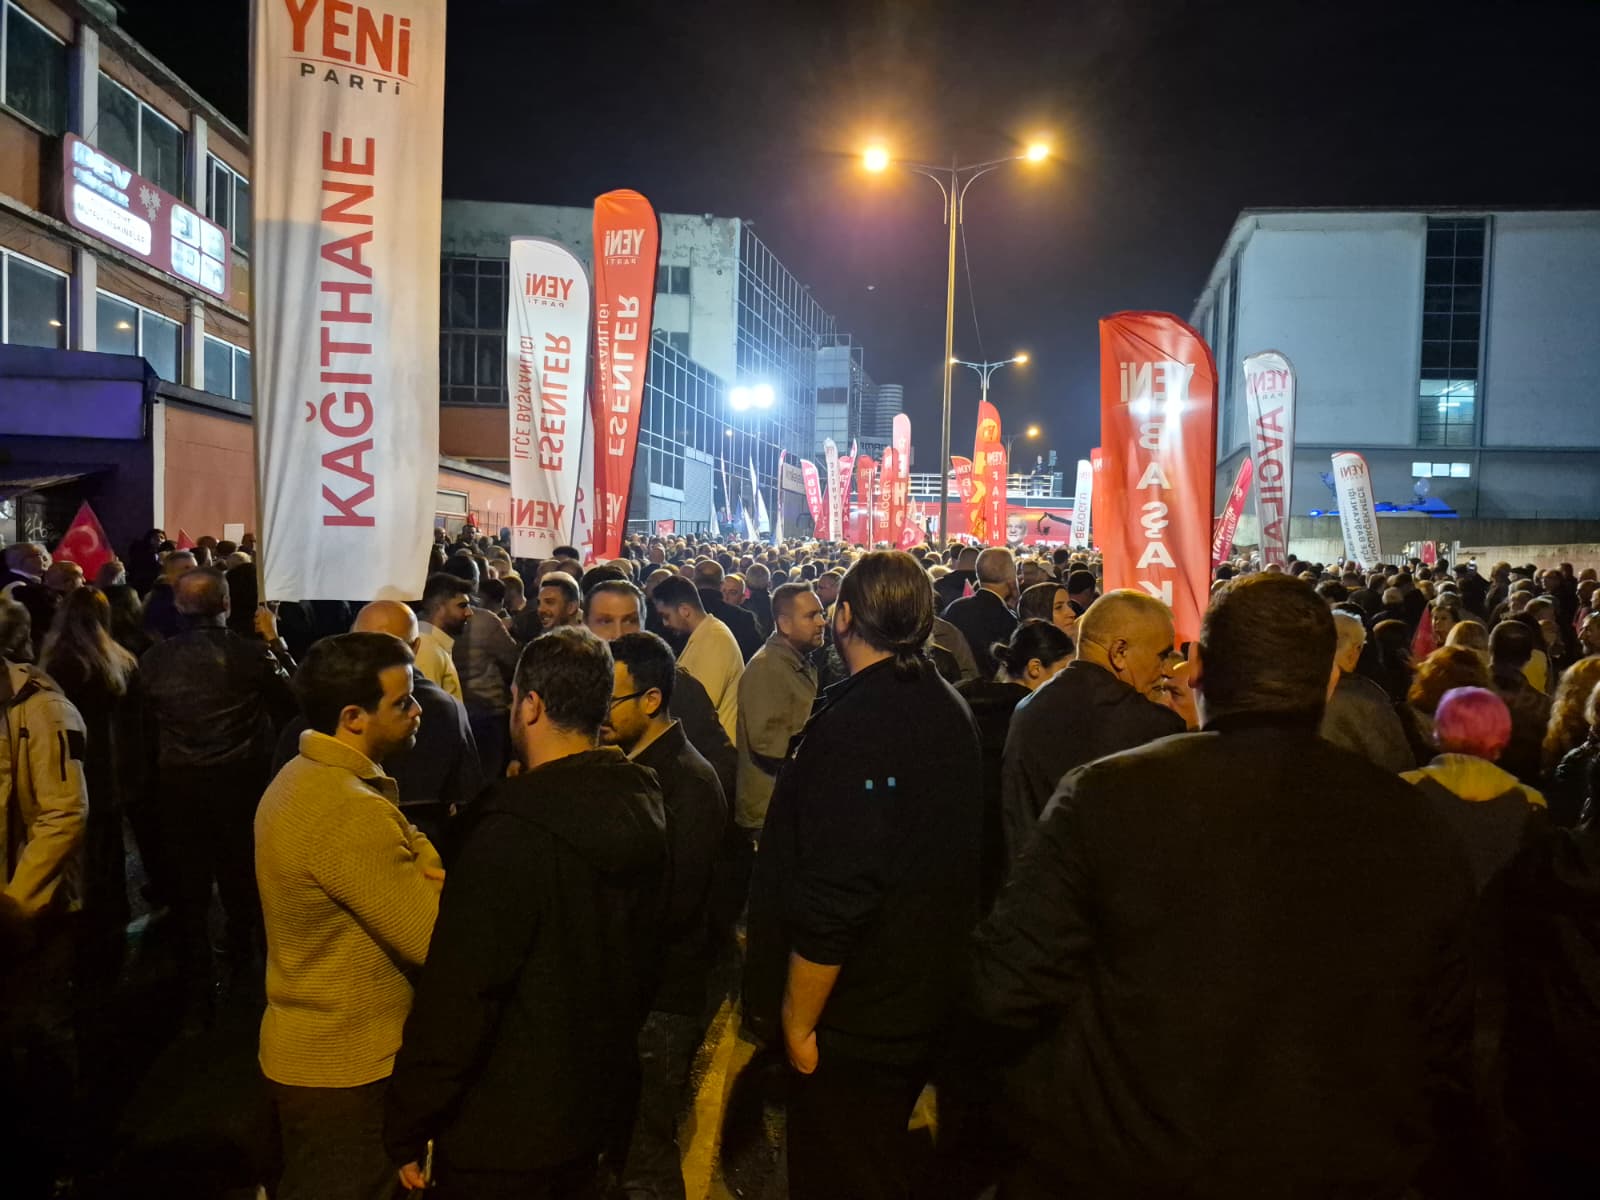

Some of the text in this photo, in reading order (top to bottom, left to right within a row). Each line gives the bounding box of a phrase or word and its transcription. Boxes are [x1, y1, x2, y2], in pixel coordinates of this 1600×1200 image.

[284, 0, 411, 77] YENİ
[300, 62, 400, 95] PARTİ
[305, 131, 376, 527] KAĞITHANE
